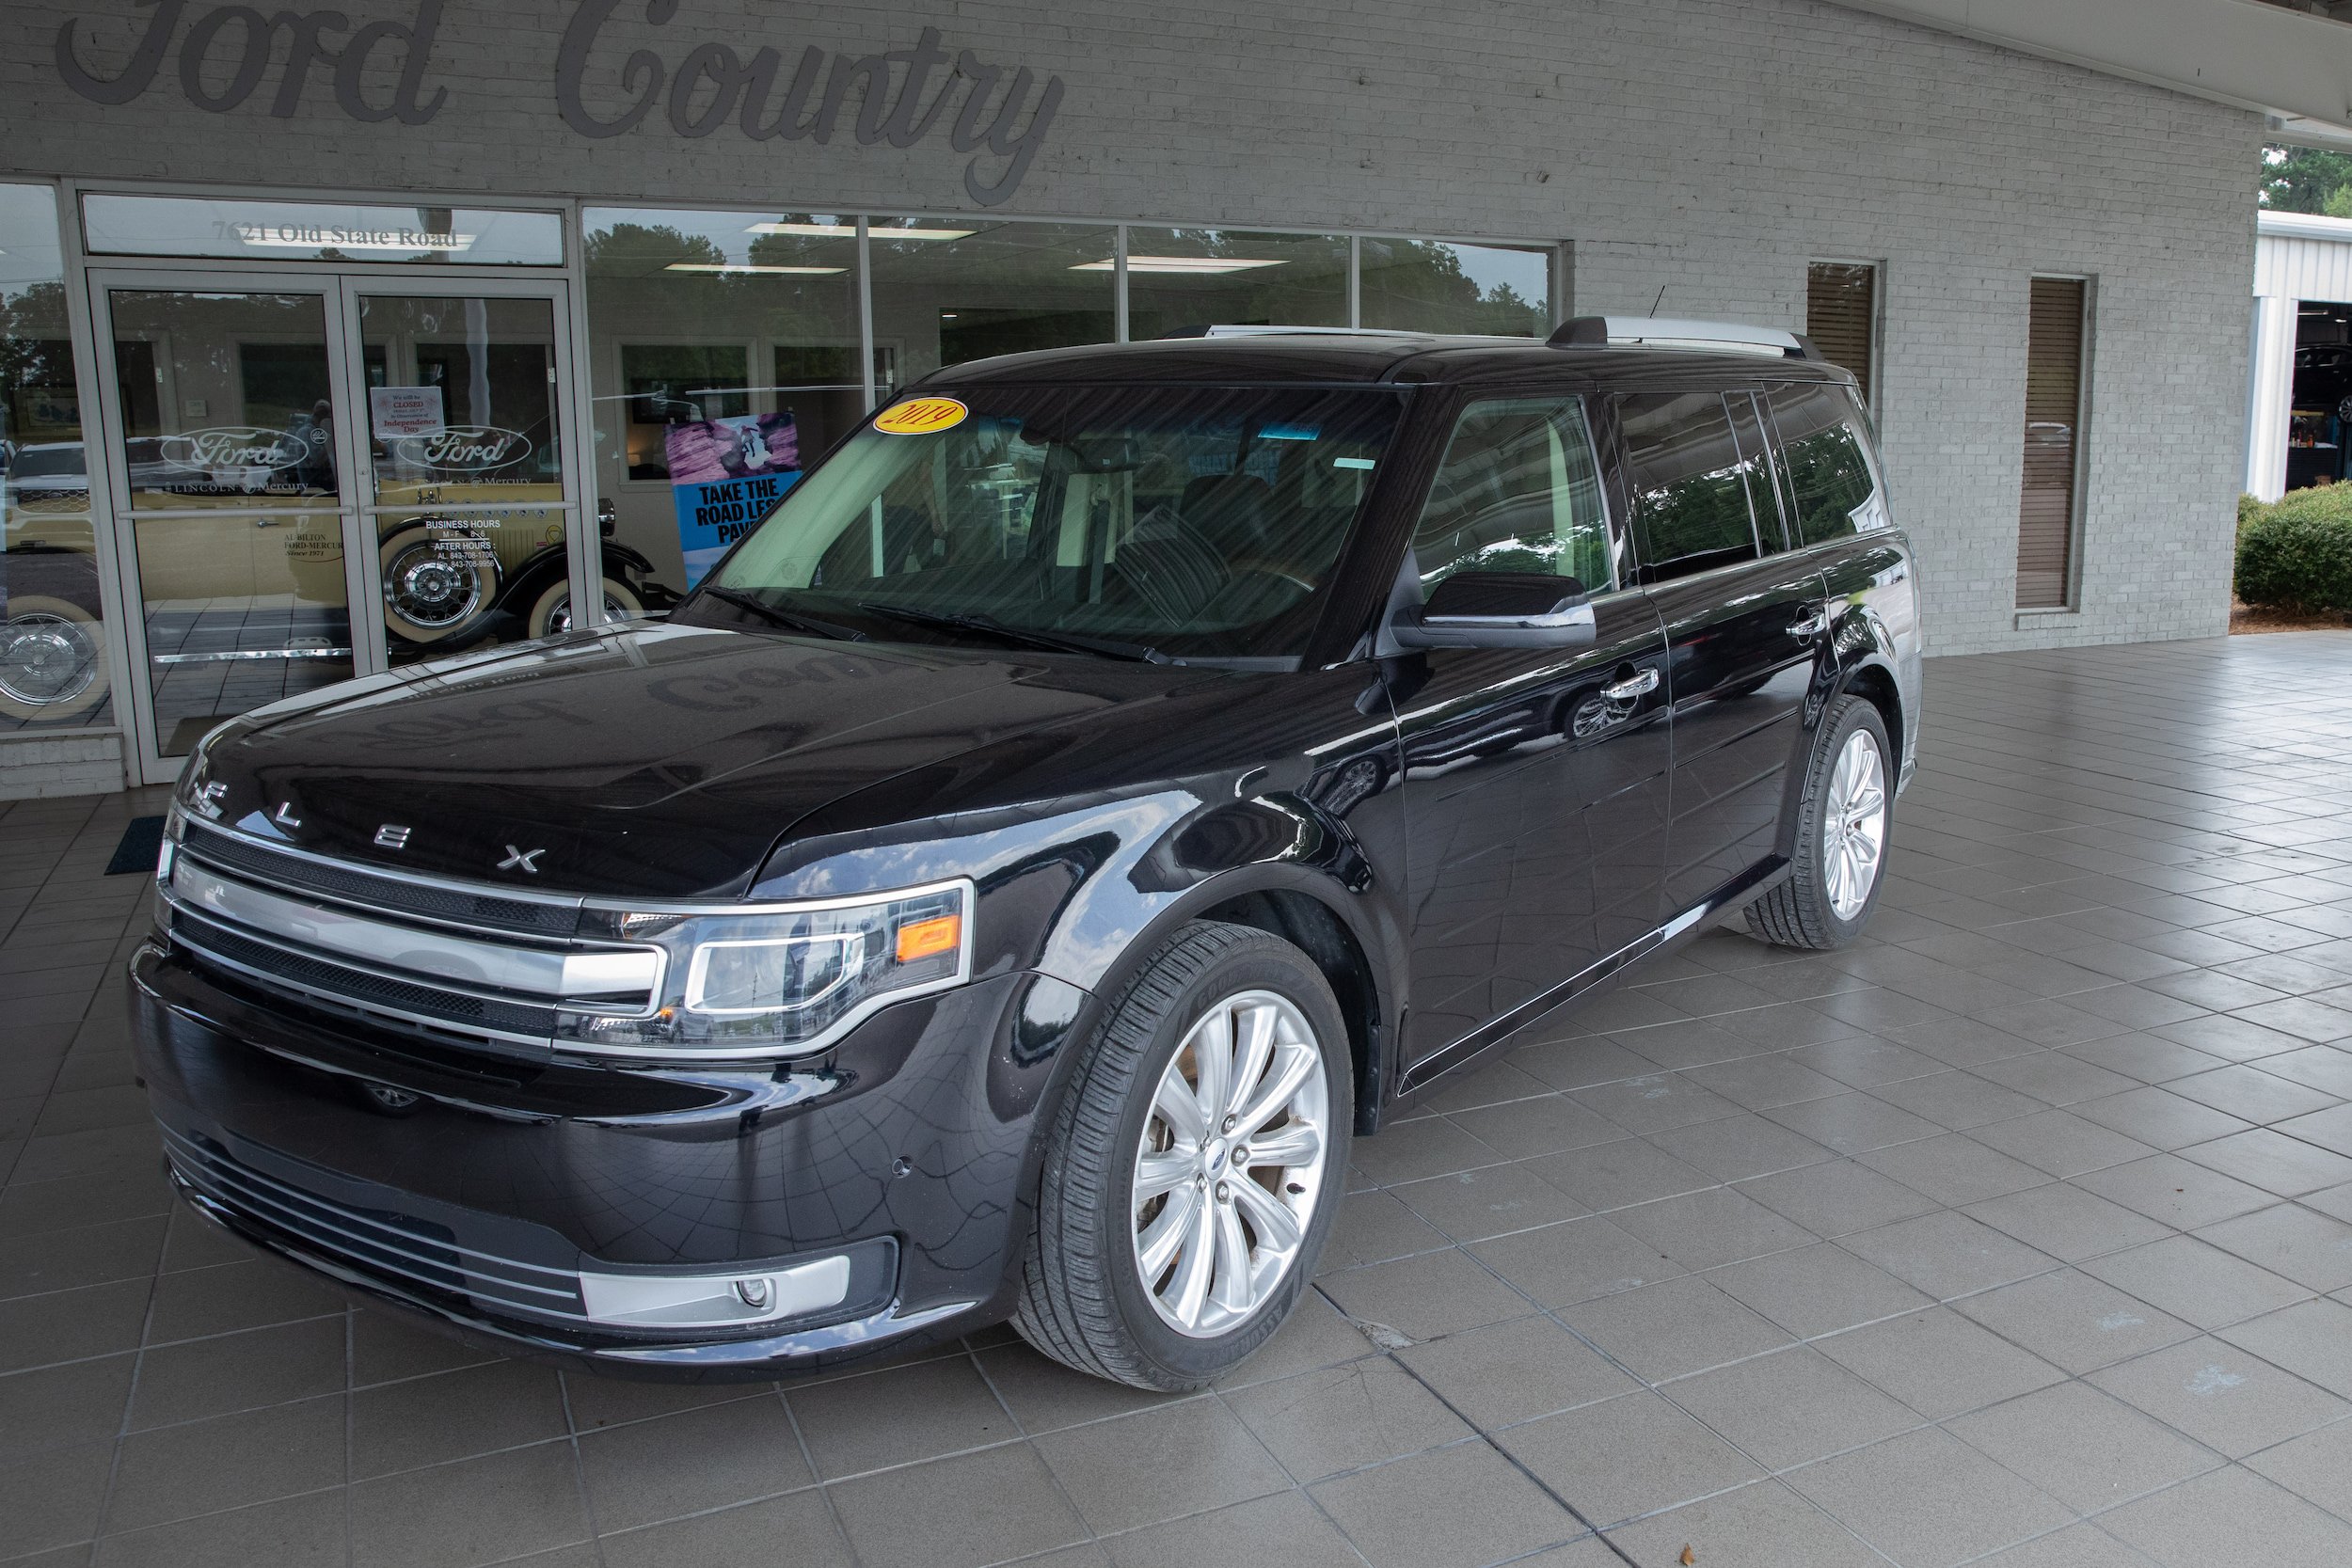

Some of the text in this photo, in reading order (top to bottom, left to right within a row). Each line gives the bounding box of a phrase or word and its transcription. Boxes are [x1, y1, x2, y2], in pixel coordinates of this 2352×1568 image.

[555, 0, 1065, 207] Country
[212, 220, 458, 247] 7621 Old State Road
[384, 419, 437, 427] Independence
[882, 404, 958, 426] 2019
[191, 432, 281, 466] Ford
[424, 430, 505, 463] Ford
[175, 484, 236, 493] LINCOLN
[257, 482, 309, 492] Mercury
[485, 477, 532, 486] Mercury
[698, 478, 780, 505] TAKE THE
[695, 498, 776, 527] ROAD LE
[425, 519, 501, 530] BUSINESS HOURS
[718, 520, 755, 544] PAV
[296, 533, 326, 542] BILTON
[434, 542, 461, 550] AFTER
[462, 541, 491, 550] HOURS
[202, 780, 547, 873] FLEX
